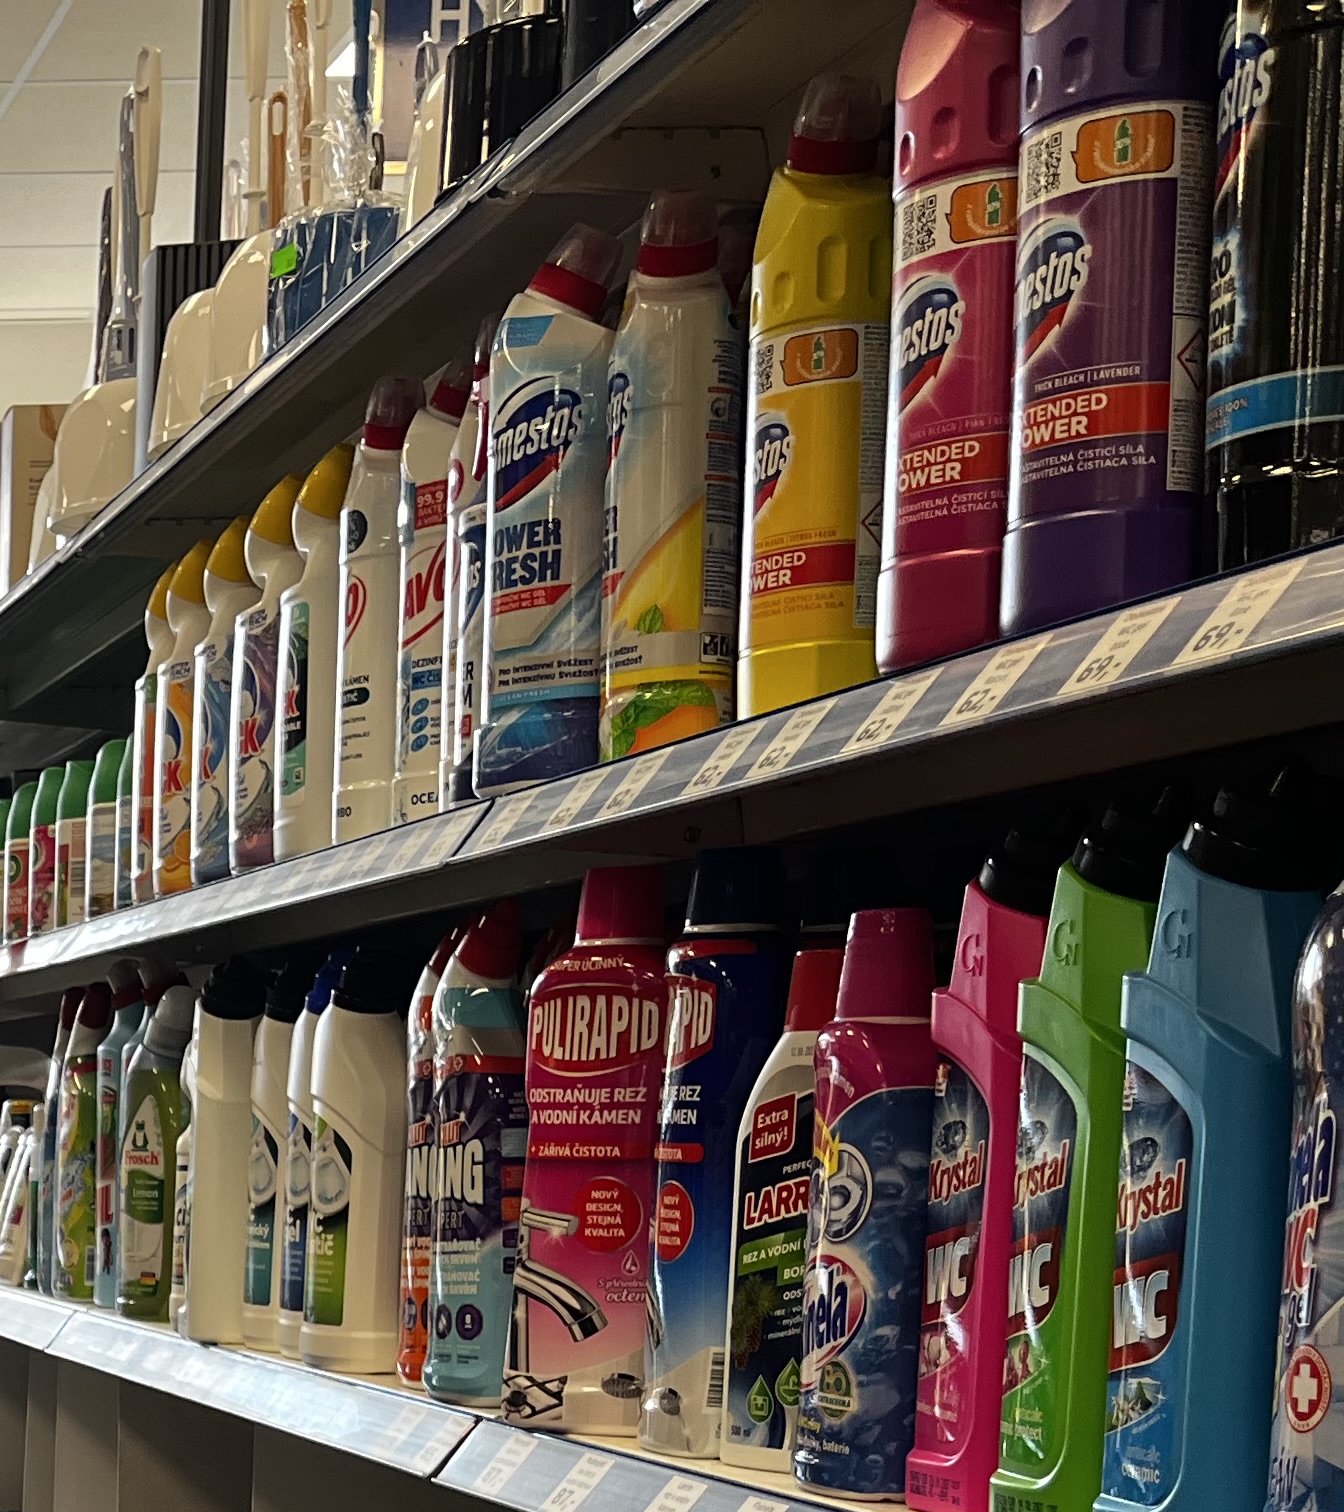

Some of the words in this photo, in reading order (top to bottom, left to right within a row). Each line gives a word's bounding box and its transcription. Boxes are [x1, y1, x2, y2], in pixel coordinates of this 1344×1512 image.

[1057, 370, 1085, 389] BLEACH
[1093, 365, 1141, 383] LAVENDER
[1077, 444, 1117, 461] ČISTICÍ
[1119, 442, 1145, 456] SÍLA
[1077, 454, 1129, 472] ČISTIACA
[493, 519, 562, 558] OWER
[493, 550, 562, 590] RESH
[1193, 621, 1244, 653] 69,-
[1076, 655, 1121, 685] 69,-
[956, 689, 998, 715] 62,-
[532, 994, 659, 1063] PULIRAPID
[529, 1083, 610, 1103] ODSTRAŇUJE
[614, 1086, 647, 1102] REZ
[539, 1106, 577, 1125] VODNÍ
[579, 1104, 641, 1125] KÁMEN
[757, 1108, 788, 1128] Extra
[538, 1142, 570, 1158] ZÁŘIVÁ
[572, 1142, 620, 1158] ČISTOTA
[755, 1129, 788, 1151] silný!
[125, 1149, 158, 1166] Frosch
[929, 1140, 985, 1205] Krystal
[591, 1187, 619, 1200] NOVÝ
[586, 1212, 622, 1227] STEJNÁ
[584, 1227, 626, 1239] KVALITA
[743, 1252, 757, 1265] REZ
[767, 1241, 801, 1262] VODNÍ
[926, 1236, 971, 1305] WC
[606, 1288, 648, 1303] octem
[1113, 1271, 1168, 1349] WC
